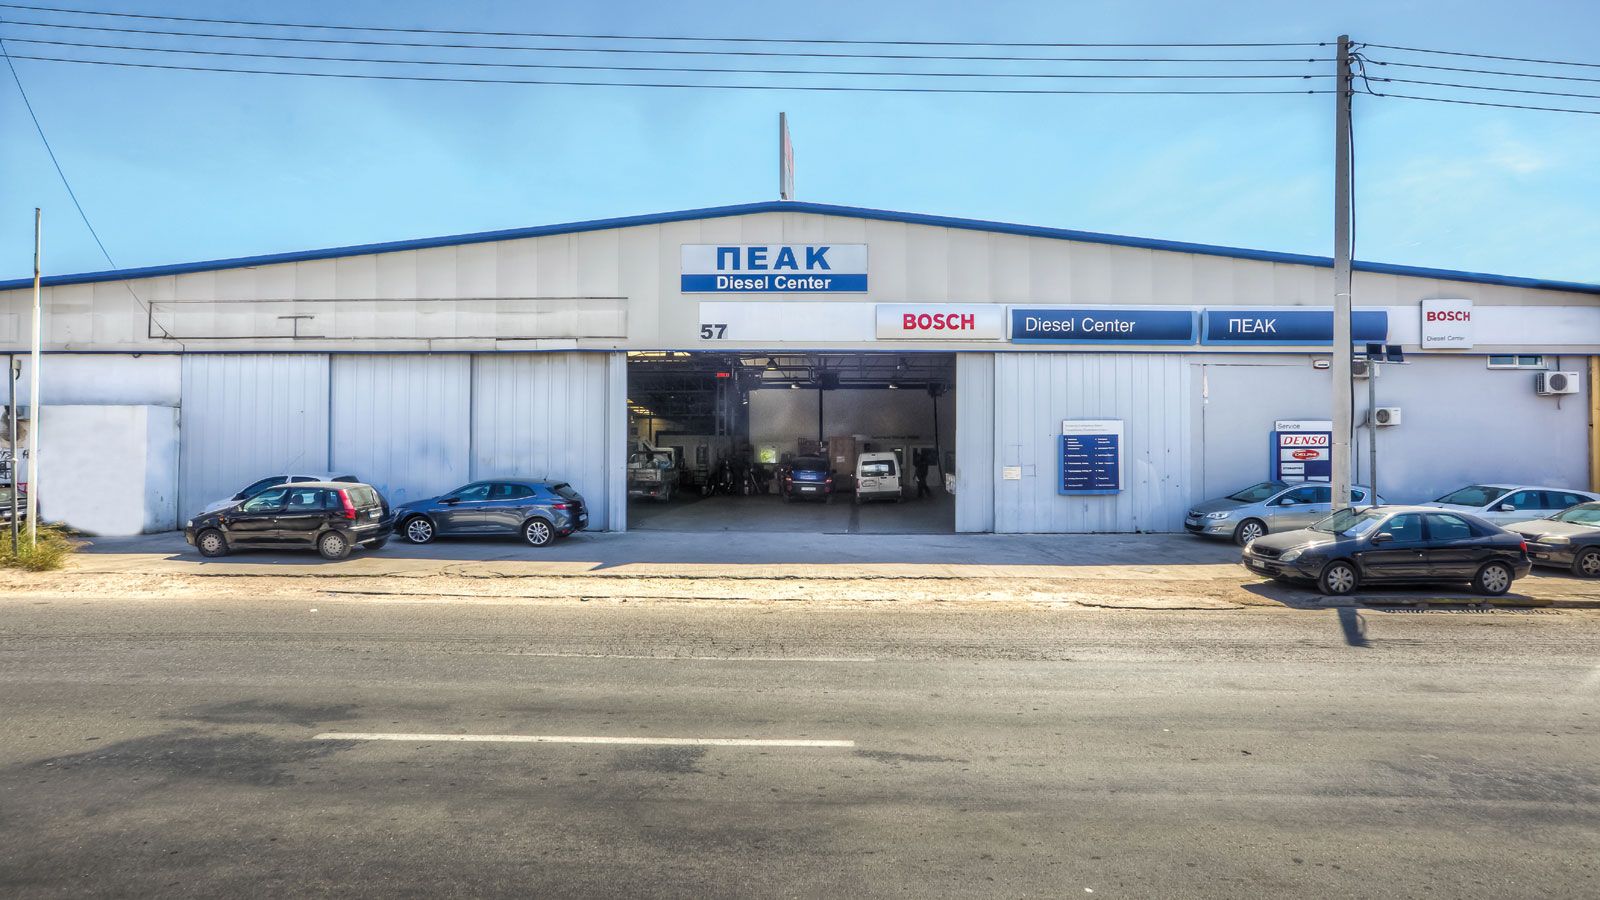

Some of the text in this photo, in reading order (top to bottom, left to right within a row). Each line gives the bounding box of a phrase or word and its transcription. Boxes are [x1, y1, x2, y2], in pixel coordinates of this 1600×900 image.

[717, 246, 831, 271] ΠΕΑΚ
[716, 275, 832, 290] Diesel Center
[903, 313, 975, 330] BOSCH
[1426, 311, 1471, 322] BOSCH
[700, 323, 728, 340] 57
[1025, 317, 1136, 333] Diesel Center
[1229, 318, 1277, 333] ΠΕΑΚ
[1283, 436, 1327, 445] DENSO
